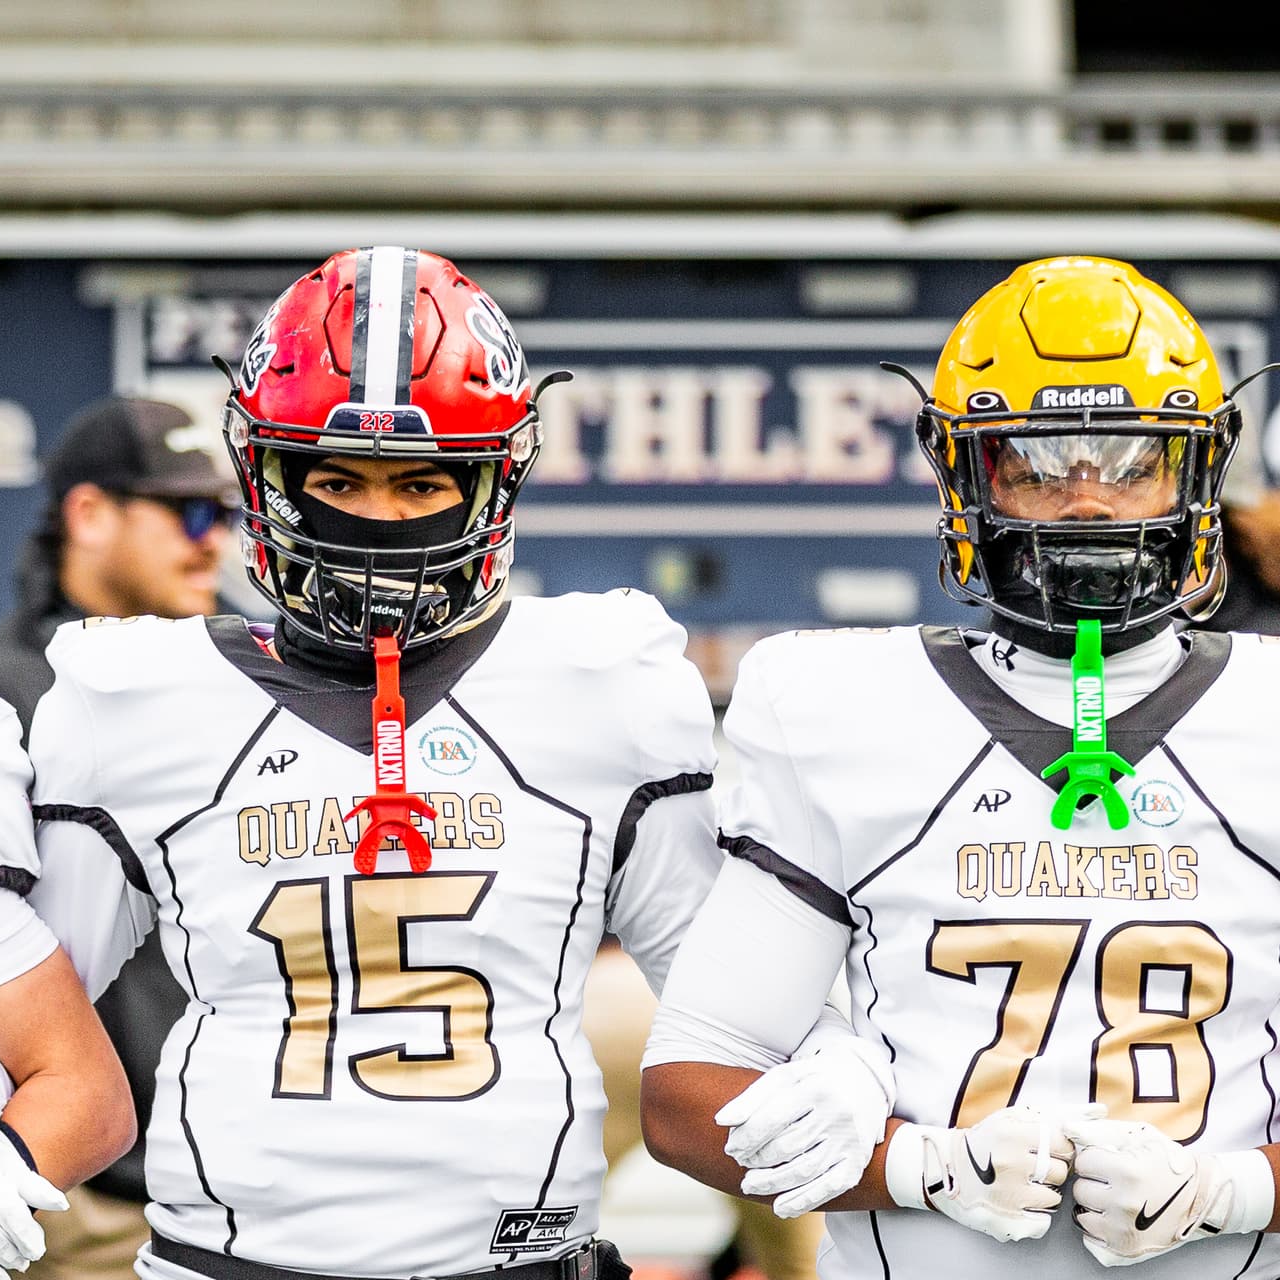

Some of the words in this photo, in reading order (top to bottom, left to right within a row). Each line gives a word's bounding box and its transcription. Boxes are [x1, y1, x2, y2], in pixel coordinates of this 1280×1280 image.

[359, 413, 394, 432] 212
[532, 363, 932, 486] THLE
[1042, 386, 1124, 408] Riddell
[1076, 677, 1102, 742] NXTRND
[257, 749, 299, 776] AP
[377, 720, 404, 785] NXTRND
[236, 791, 505, 868] QUARS
[972, 788, 1012, 814] AP
[956, 840, 1199, 902] QUAKERS
[247, 870, 501, 1102] 15
[925, 918, 1234, 1147] 78
